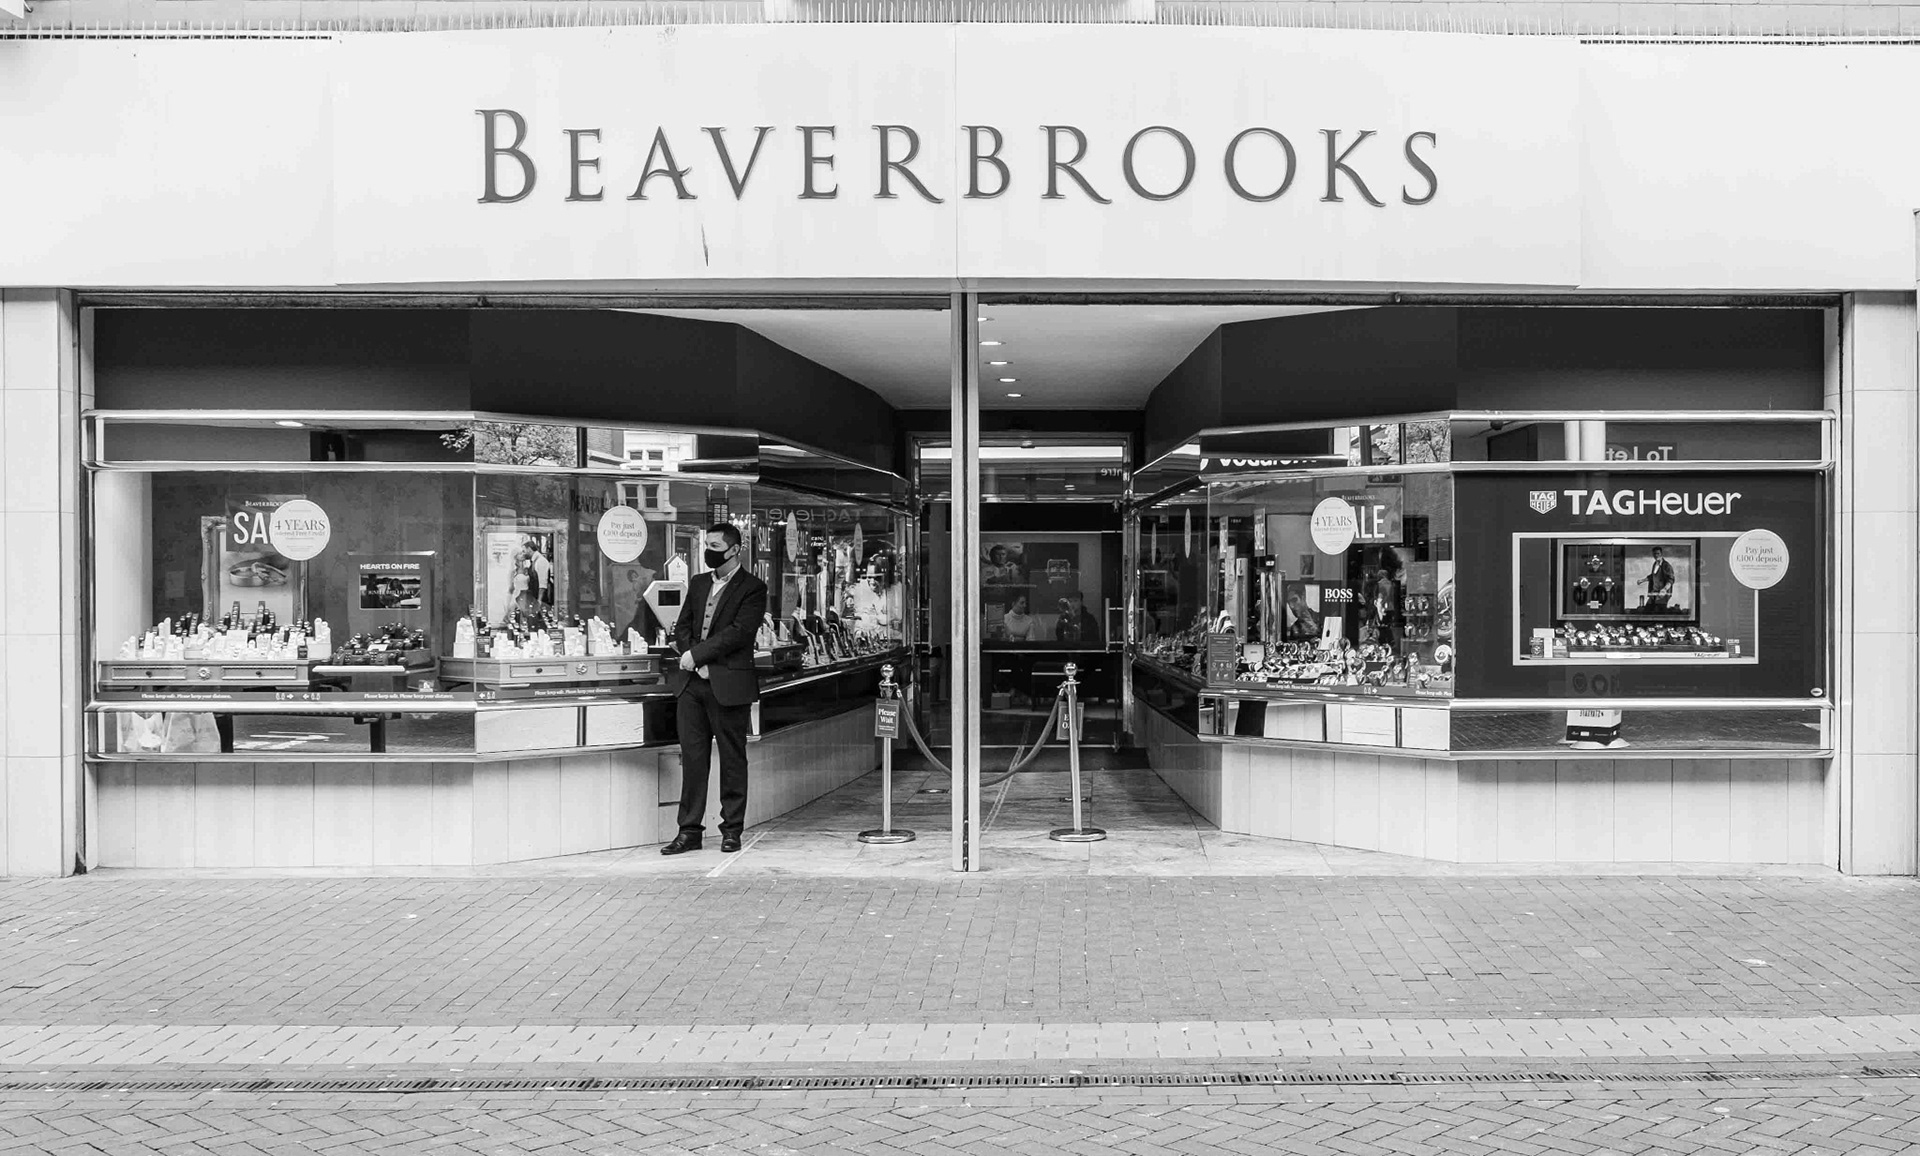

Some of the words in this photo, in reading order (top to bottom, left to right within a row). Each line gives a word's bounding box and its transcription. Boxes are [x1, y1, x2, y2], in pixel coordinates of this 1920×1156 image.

[475, 108, 1439, 207] BEAVERBROOKS
[1532, 492, 1555, 500] TAG
[1531, 500, 1556, 513] HEUER
[285, 519, 326, 531] YEARS
[610, 521, 621, 531] Pay
[1322, 515, 1353, 527] YEARS
[1350, 505, 1386, 539] ALE
[233, 512, 276, 545] SA
[619, 529, 642, 538] deposit
[1745, 546, 1759, 555] Pay
[1756, 554, 1783, 564] deposit
[1325, 588, 1353, 599] BOSS
[878, 708, 897, 717] Please
[880, 715, 894, 724] Wait
